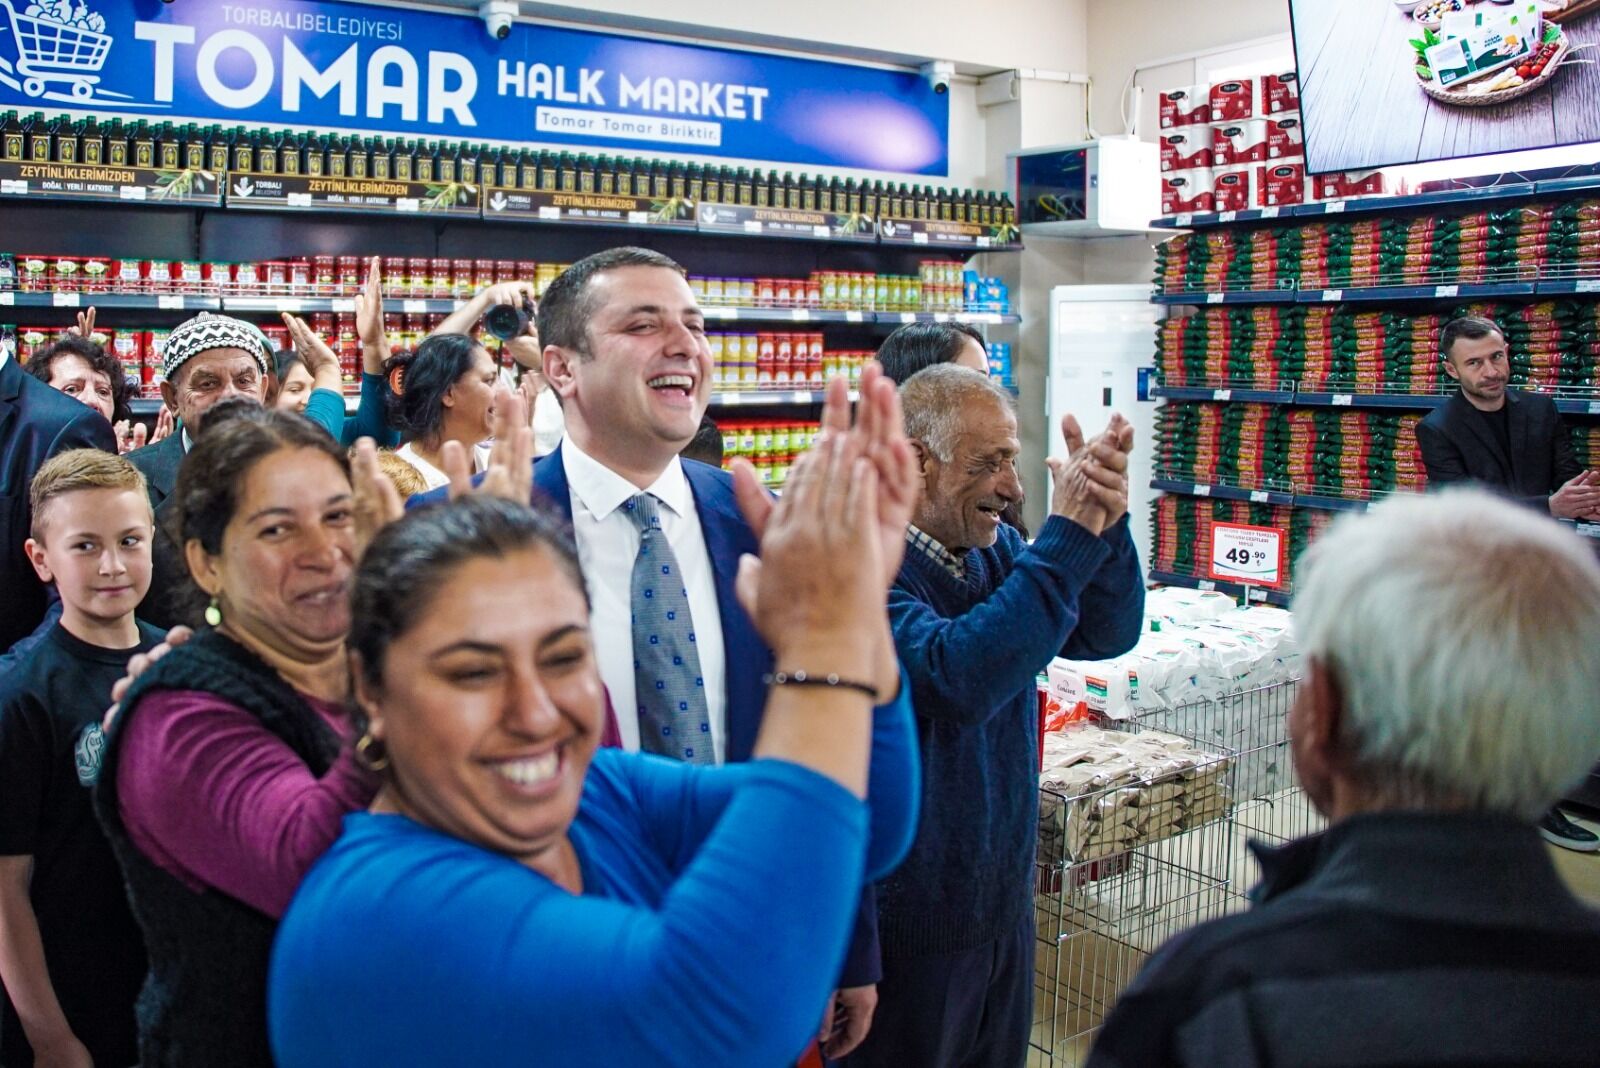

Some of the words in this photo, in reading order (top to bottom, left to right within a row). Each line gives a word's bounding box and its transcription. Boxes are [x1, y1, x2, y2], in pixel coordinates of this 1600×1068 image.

[134, 21, 478, 126] TOMAR
[498, 59, 605, 105] HALK
[619, 72, 768, 121] MARKET
[541, 112, 594, 129] Tomar
[603, 118, 653, 134] Tomar
[661, 123, 717, 141] Biriktir.
[20, 164, 135, 183] ZEYTİNLİKLERİMİZDEN
[308, 179, 408, 195] ZEYTİNLİKLERİMİZDEN
[1226, 548, 1249, 564] 49
